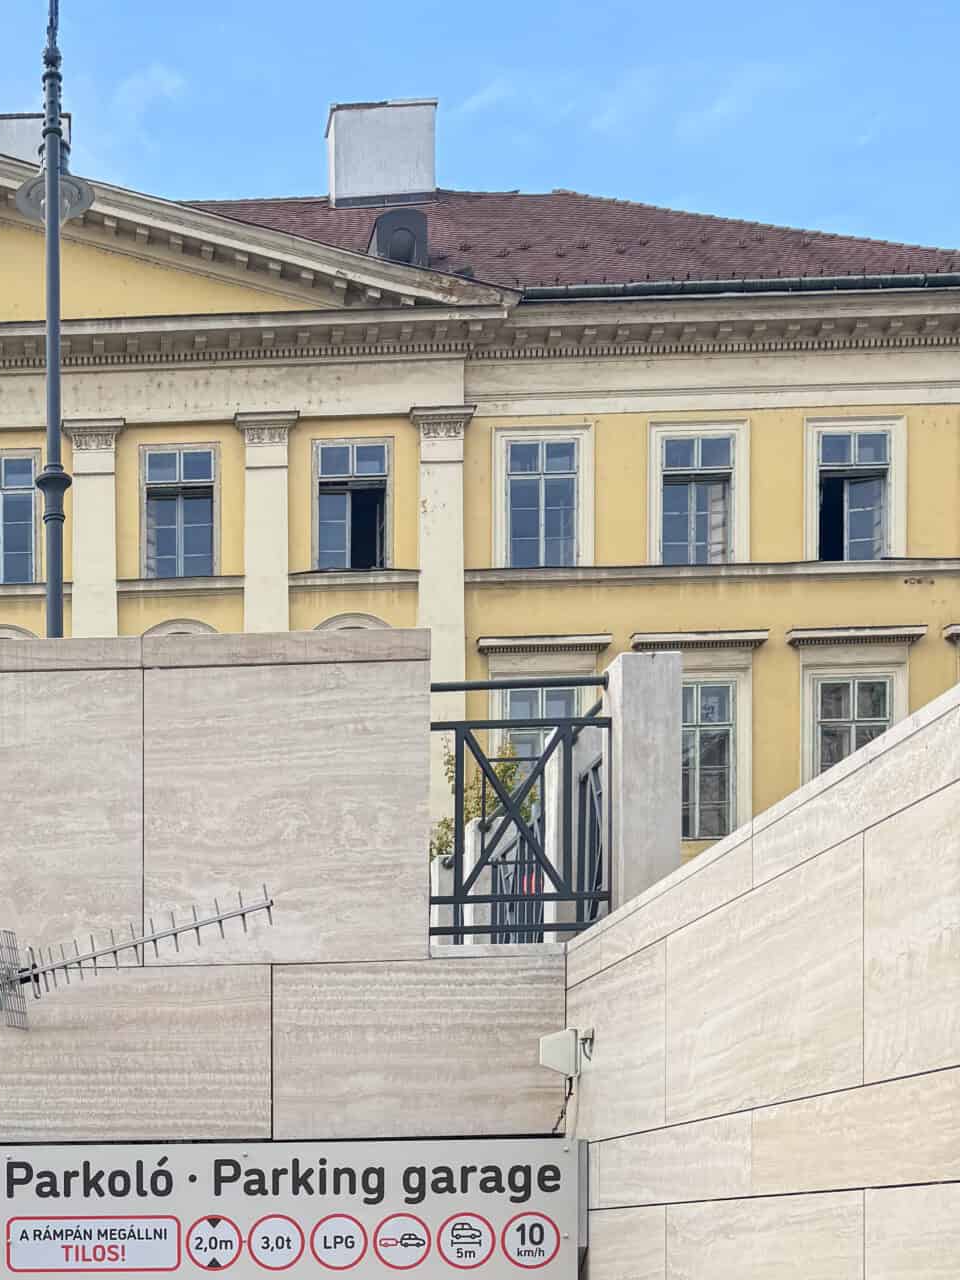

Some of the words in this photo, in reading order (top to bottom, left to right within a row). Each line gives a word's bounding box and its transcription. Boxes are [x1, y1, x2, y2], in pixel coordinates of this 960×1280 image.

[6, 1156, 174, 1198] Parkoló
[214, 1157, 385, 1205] Parking
[402, 1164, 561, 1205] garage
[20, 1229, 30, 1241] A
[33, 1226, 93, 1241] RÁMPÁN
[97, 1225, 168, 1241] MEGÁLLNI
[516, 1222, 545, 1245] 10
[194, 1235, 234, 1252] 2,0m
[260, 1235, 292, 1252] 3,0t
[323, 1235, 356, 1250] LPG
[61, 1244, 126, 1263] TILOS!
[456, 1247, 477, 1260] 5m
[516, 1246, 546, 1259] km/h
